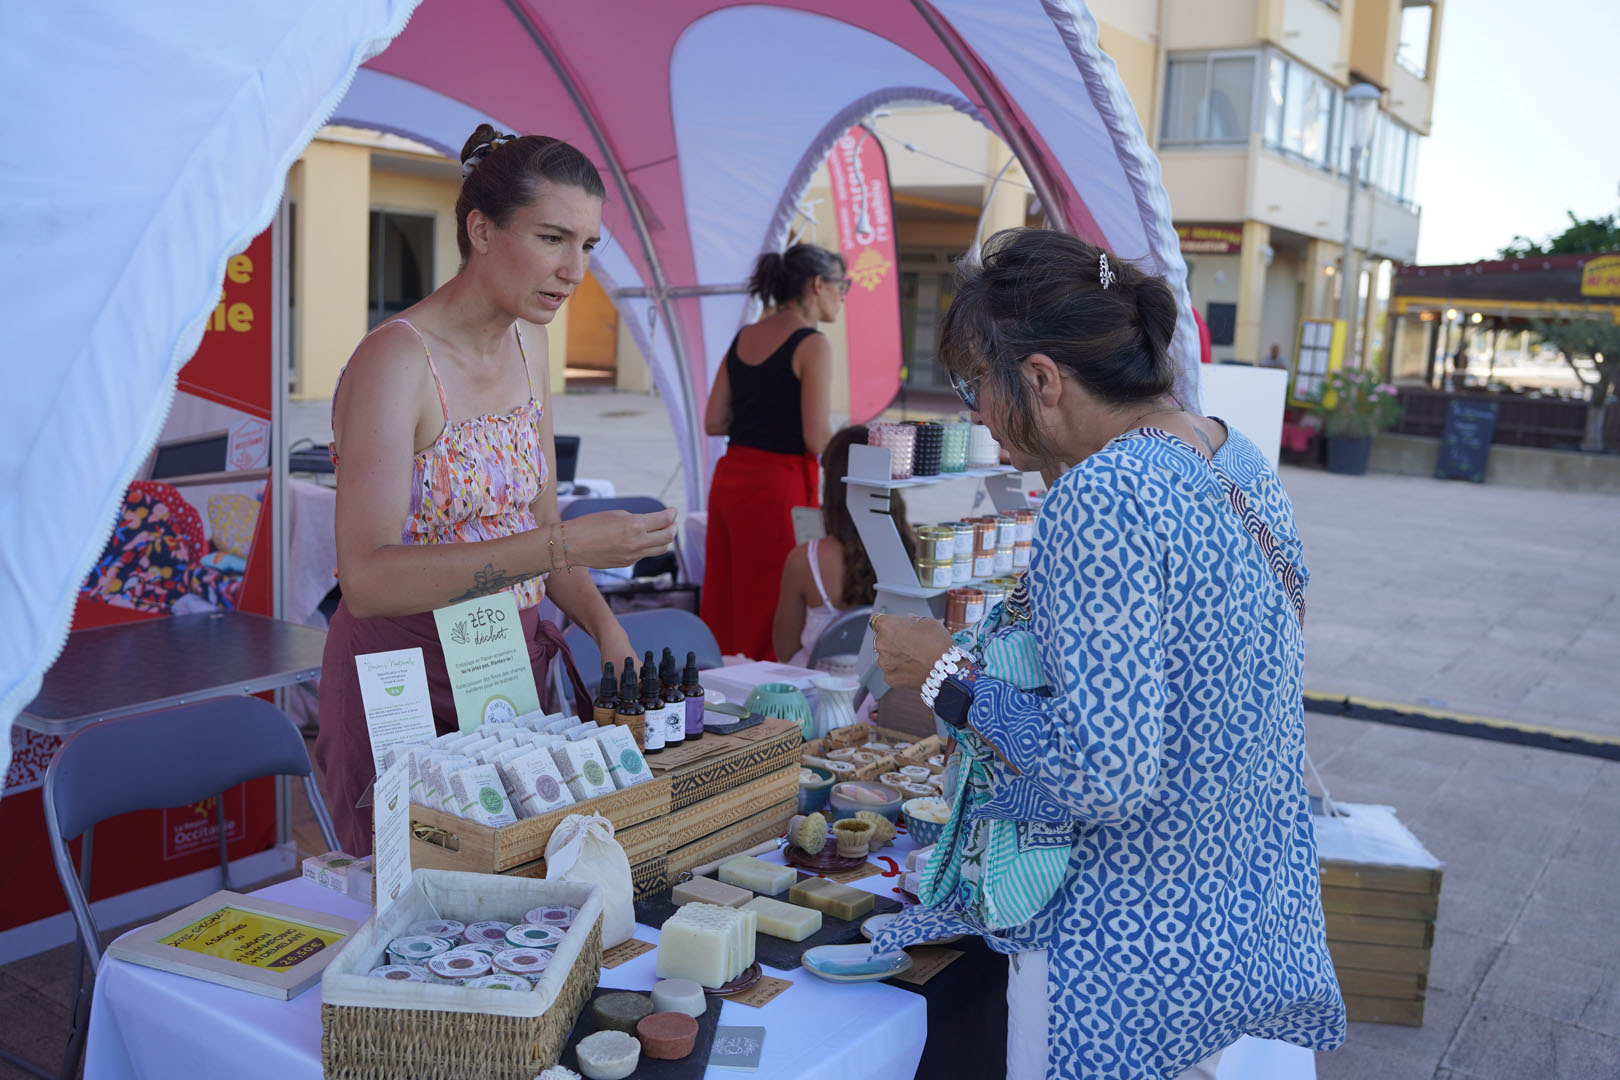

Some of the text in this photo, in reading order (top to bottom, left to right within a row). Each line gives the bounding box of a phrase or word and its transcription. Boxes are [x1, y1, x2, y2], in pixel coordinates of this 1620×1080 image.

[468, 607, 505, 628] ZÉRO
[474, 624, 509, 646] déchet
[174, 820, 236, 845] Occitaie
